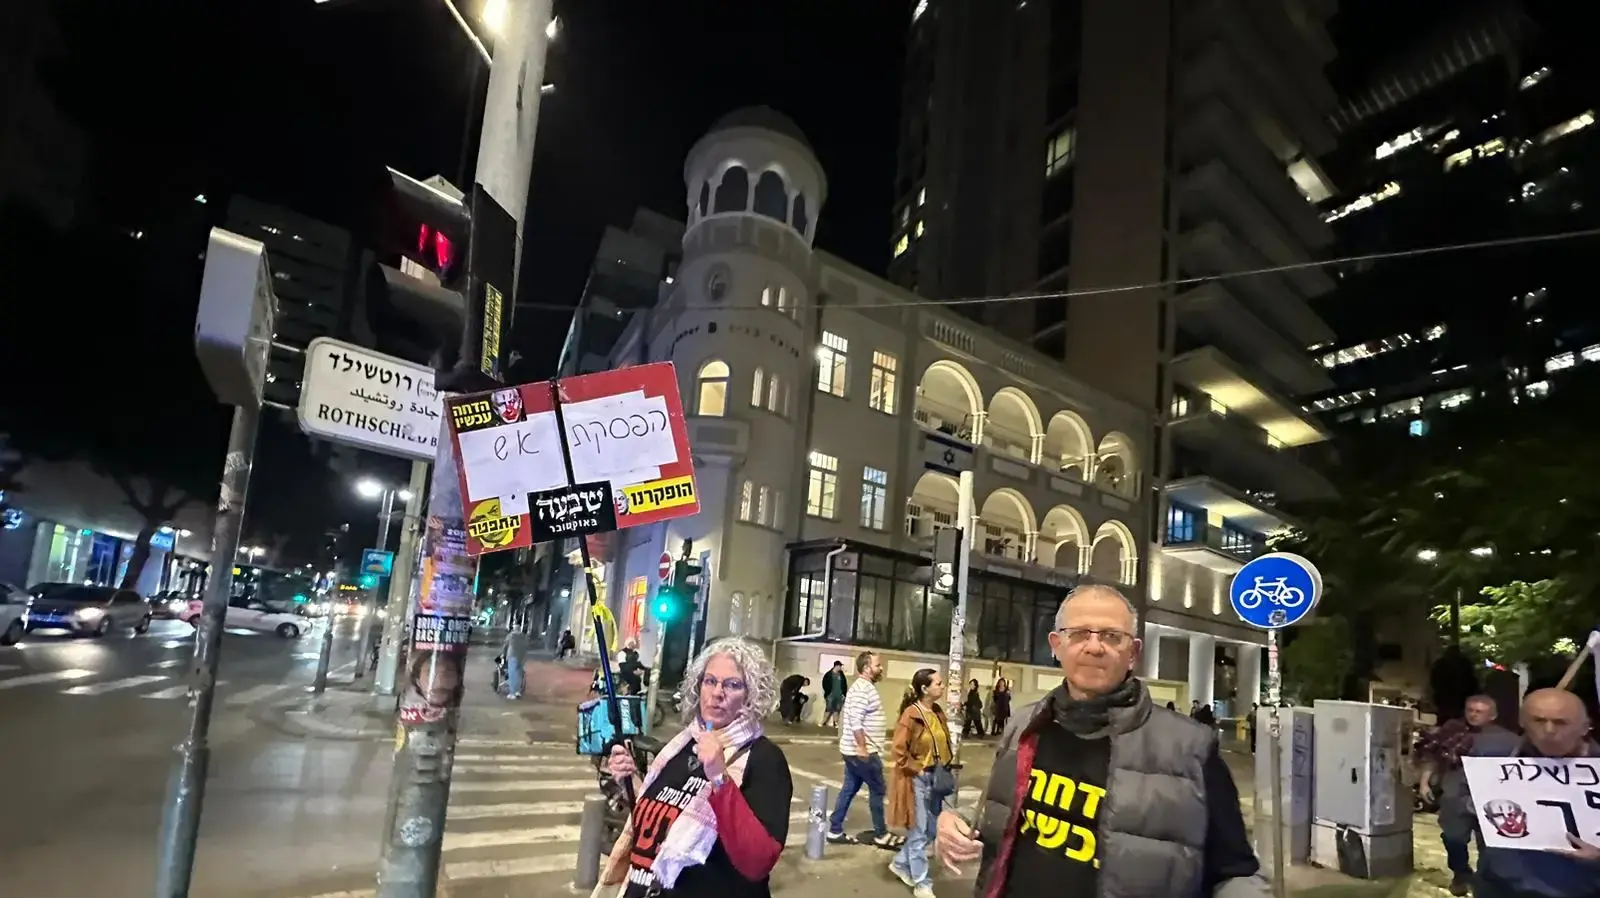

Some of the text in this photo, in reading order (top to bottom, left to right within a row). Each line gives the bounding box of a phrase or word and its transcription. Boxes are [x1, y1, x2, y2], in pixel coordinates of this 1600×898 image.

[329, 352, 412, 391] רוטשילד
[409, 402, 439, 420] جادة
[452, 400, 490, 417] הדחה
[455, 411, 492, 428] עכשיו
[431, 437, 438, 448] B
[494, 410, 667, 461] הפסקת אש
[630, 482, 693, 506] הופקרנו
[416, 616, 445, 631] BRING
[415, 629, 441, 642] BACK
